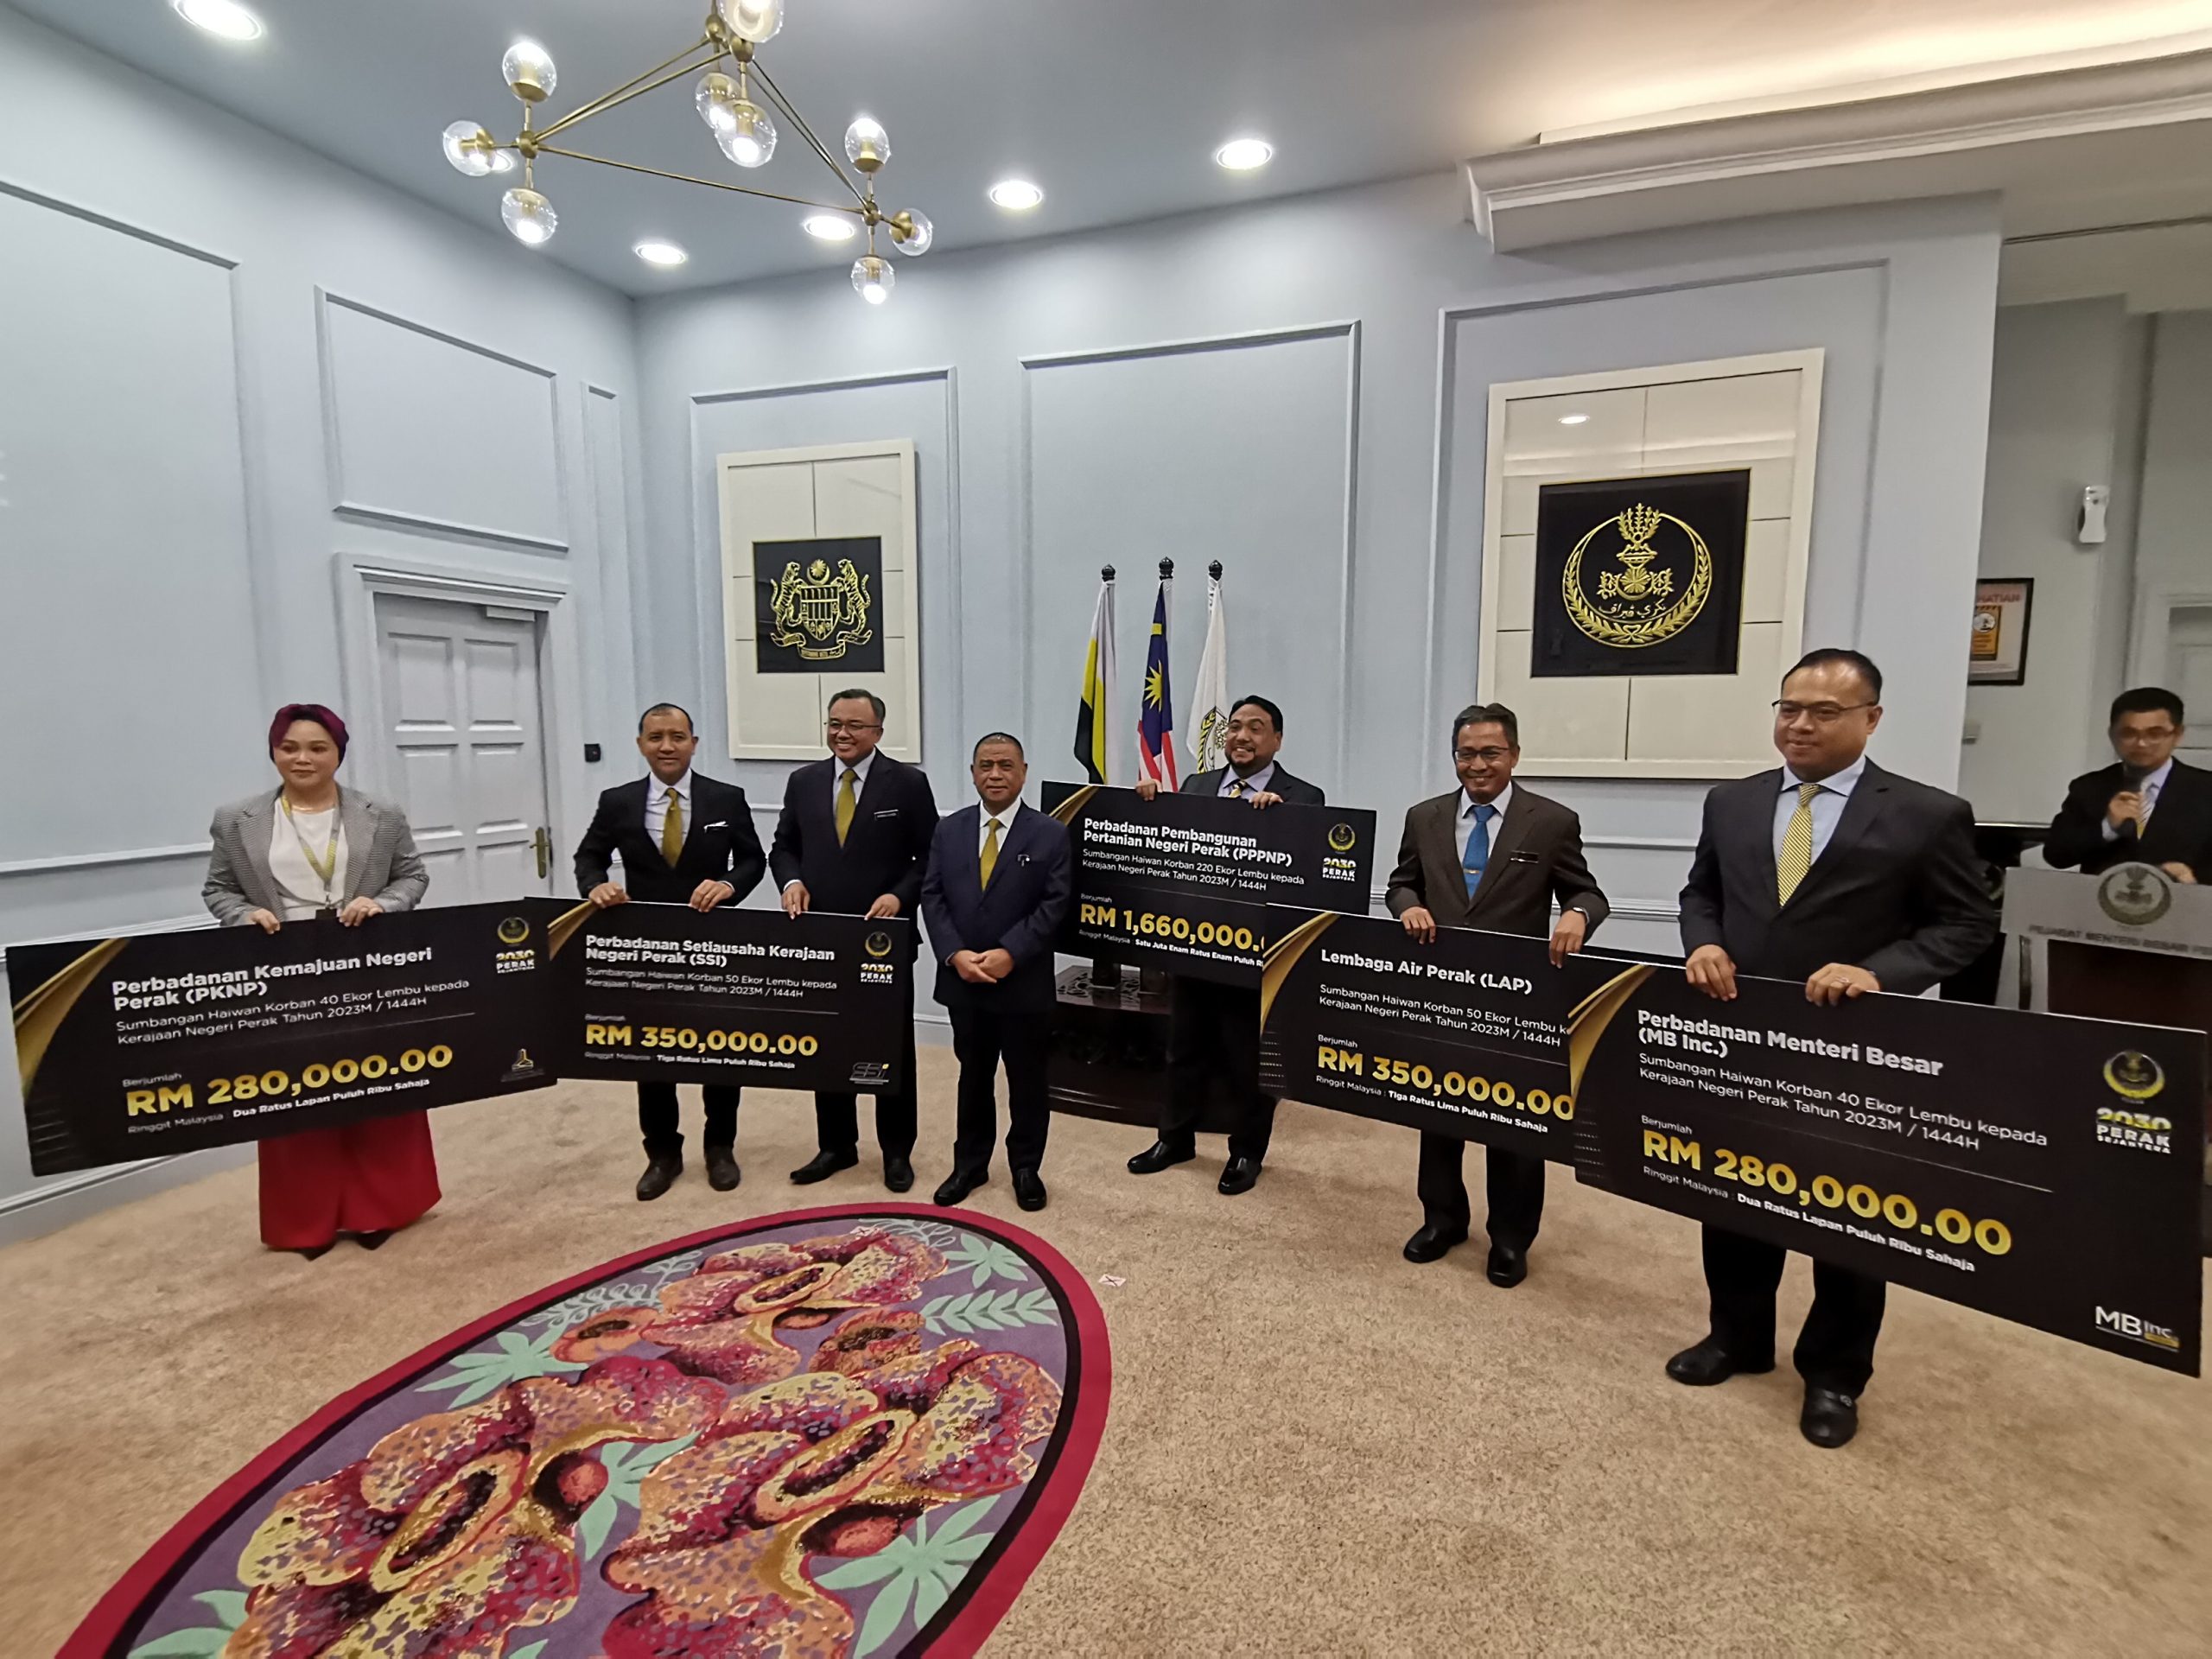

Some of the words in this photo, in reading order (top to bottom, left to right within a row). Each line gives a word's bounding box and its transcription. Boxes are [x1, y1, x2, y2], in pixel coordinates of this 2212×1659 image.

[1084, 817, 1158, 836] Perbadanan
[1161, 826, 1256, 848] Pembangunan
[1084, 830, 1142, 847] Pertanian
[1146, 836, 1188, 853] Negeri
[1192, 842, 1230, 858] Perak
[1233, 848, 1292, 868] (PPPNP)
[1082, 859, 1116, 871] Kerajaan
[1118, 863, 1145, 874] Negeri
[1147, 868, 1171, 878] Perak
[1173, 870, 1198, 881] Tahun
[1199, 874, 1229, 887] 2023M
[1238, 880, 1266, 891] 1444H
[1083, 849, 1130, 861] Sumbangan
[1132, 855, 1161, 865] Haiwan
[1164, 859, 1194, 870] Korban
[1196, 862, 1213, 872] 220
[1215, 865, 1236, 874] Ekor
[1237, 868, 1268, 880] Lembu
[1271, 872, 1305, 885] kepada
[1323, 868, 1355, 877] PERAK
[1080, 903, 1116, 928] RM
[1123, 910, 1264, 952] 1,660,000.
[496, 959, 535, 970] PERAK
[586, 934, 679, 950] Perbadanan
[683, 940, 766, 957] Setiausaha
[769, 945, 835, 961] Kerajaan
[586, 948, 639, 962] Negeri
[641, 950, 686, 963] Perak
[690, 953, 728, 968] (SSI)
[1103, 933, 1130, 944] Malaysia
[1135, 938, 1151, 947] Satu
[1152, 941, 1167, 950] Juta
[1169, 944, 1188, 954] Enam
[1190, 948, 1210, 958] Ratus
[1211, 951, 1232, 962] Enam
[1234, 956, 1255, 966] Puluh
[112, 969, 249, 995] Perbadanan
[254, 957, 361, 979] Kemajuan
[366, 947, 432, 967] Negeri
[586, 967, 645, 979] Sumbangan
[687, 973, 723, 982] Korban
[726, 974, 739, 983] 50
[741, 975, 764, 984] Ekor
[766, 977, 799, 987] Lembu
[802, 979, 837, 989] kepada
[667, 982, 695, 992] Perak
[698, 984, 728, 993] Tahun
[729, 986, 762, 995] 2023M
[772, 988, 804, 997] 1444H
[1321, 949, 1394, 972] Lembaga
[1397, 960, 1423, 976] Air
[1427, 964, 1476, 984] Perak
[1480, 973, 1532, 995] (LAP)
[114, 990, 180, 1011] Perak
[185, 981, 268, 1004] (PKNP)
[116, 1013, 204, 1031] Sumbangan
[208, 1006, 261, 1020] Haiwan
[264, 998, 316, 1013] Korban
[320, 995, 339, 1005] 40
[342, 993, 372, 1003] Ekor
[377, 986, 421, 999] Lembu
[424, 980, 470, 993] kepada
[1319, 983, 1379, 1001] Sumbangan
[1382, 995, 1421, 1008] Haiwan
[1423, 1001, 1464, 1016] Korban
[1466, 1007, 1482, 1019] 50
[1484, 1011, 1511, 1024] Ekor
[1515, 1016, 1555, 1033] Lembu
[118, 1028, 182, 1045] Kerajaan
[186, 1022, 233, 1036] Negeri
[238, 1017, 278, 1029] Perak
[282, 1012, 323, 1024] Tahun
[327, 1003, 372, 1018] 2023M
[386, 996, 427, 1009] 1444H
[1319, 995, 1362, 1011] Kerajaan
[1364, 1004, 1400, 1017] Negeri
[1402, 1010, 1432, 1024] Perak
[1434, 1015, 1468, 1030] Tahun
[1470, 1022, 1510, 1037] 2023M
[1522, 1031, 1560, 1047] 1444H
[586, 1024, 632, 1046] RM
[640, 1027, 818, 1056] 350,000.00
[1318, 1034, 1357, 1048] Berjumlah
[1637, 1009, 1761, 1045] Perbadanan
[1767, 1030, 1859, 1062] Menteri
[1866, 1046, 1943, 1076] Besar
[1638, 1027, 1677, 1047] (MB
[1682, 1034, 1728, 1058] Inc.)
[126, 1083, 194, 1116] RM
[207, 1045, 453, 1105] 280,000.00
[232, 1108, 257, 1117] Dua
[259, 1103, 292, 1114] Ratus
[296, 1096, 330, 1107] Lapan
[333, 1089, 365, 1101] Puluh
[367, 1084, 392, 1095] Ribu
[394, 1078, 430, 1090] Sahaja
[1318, 1046, 1363, 1076] RM
[1372, 1056, 1573, 1121] 350,000.00
[1316, 1075, 1344, 1089] Ringgit
[1347, 1082, 1382, 1096] Malaysia
[1389, 1090, 1408, 1101] Tiga
[1409, 1094, 1435, 1107] Ratus
[1437, 1100, 1459, 1113] Lima
[1461, 1105, 1488, 1119] Puluh
[1490, 1112, 1513, 1124] Ribu
[1514, 1118, 1548, 1133] Sahaja
[1639, 1052, 1716, 1077] Sumbangan
[1719, 1068, 1772, 1089] Haiwan
[1776, 1079, 1833, 1101] Korban
[1837, 1091, 1859, 1106] 40
[1865, 1096, 1904, 1115] Ekor
[1910, 1106, 1972, 1130] Lembu
[1978, 1120, 2047, 1147] kepada
[1639, 1067, 1694, 1089] Kerajaan
[1698, 1080, 1744, 1100] Negeri
[1747, 1090, 1789, 1109] Perak
[1794, 1099, 1840, 1120] Tahun
[1844, 1109, 1902, 1134] 2023M
[1922, 1126, 1980, 1151] 1444H
[1641, 1115, 1693, 1135] Berjumlah
[2096, 1107, 2171, 1130] 2030
[2096, 1124, 2171, 1147] PERAK
[1643, 1129, 1700, 1171] RM
[1713, 1148, 2012, 1255] 280,000.00
[1643, 1166, 1680, 1185] Ringgit
[1682, 1177, 1728, 1198] Malaysia
[1737, 1193, 1761, 1208] Dua
[1764, 1201, 1800, 1219] Ratus
[1802, 1211, 1844, 1232] Lapan
[1847, 1224, 1886, 1245] Puluh
[1889, 1237, 1922, 1256] Ribu
[1925, 1249, 1975, 1272] Sahaja
